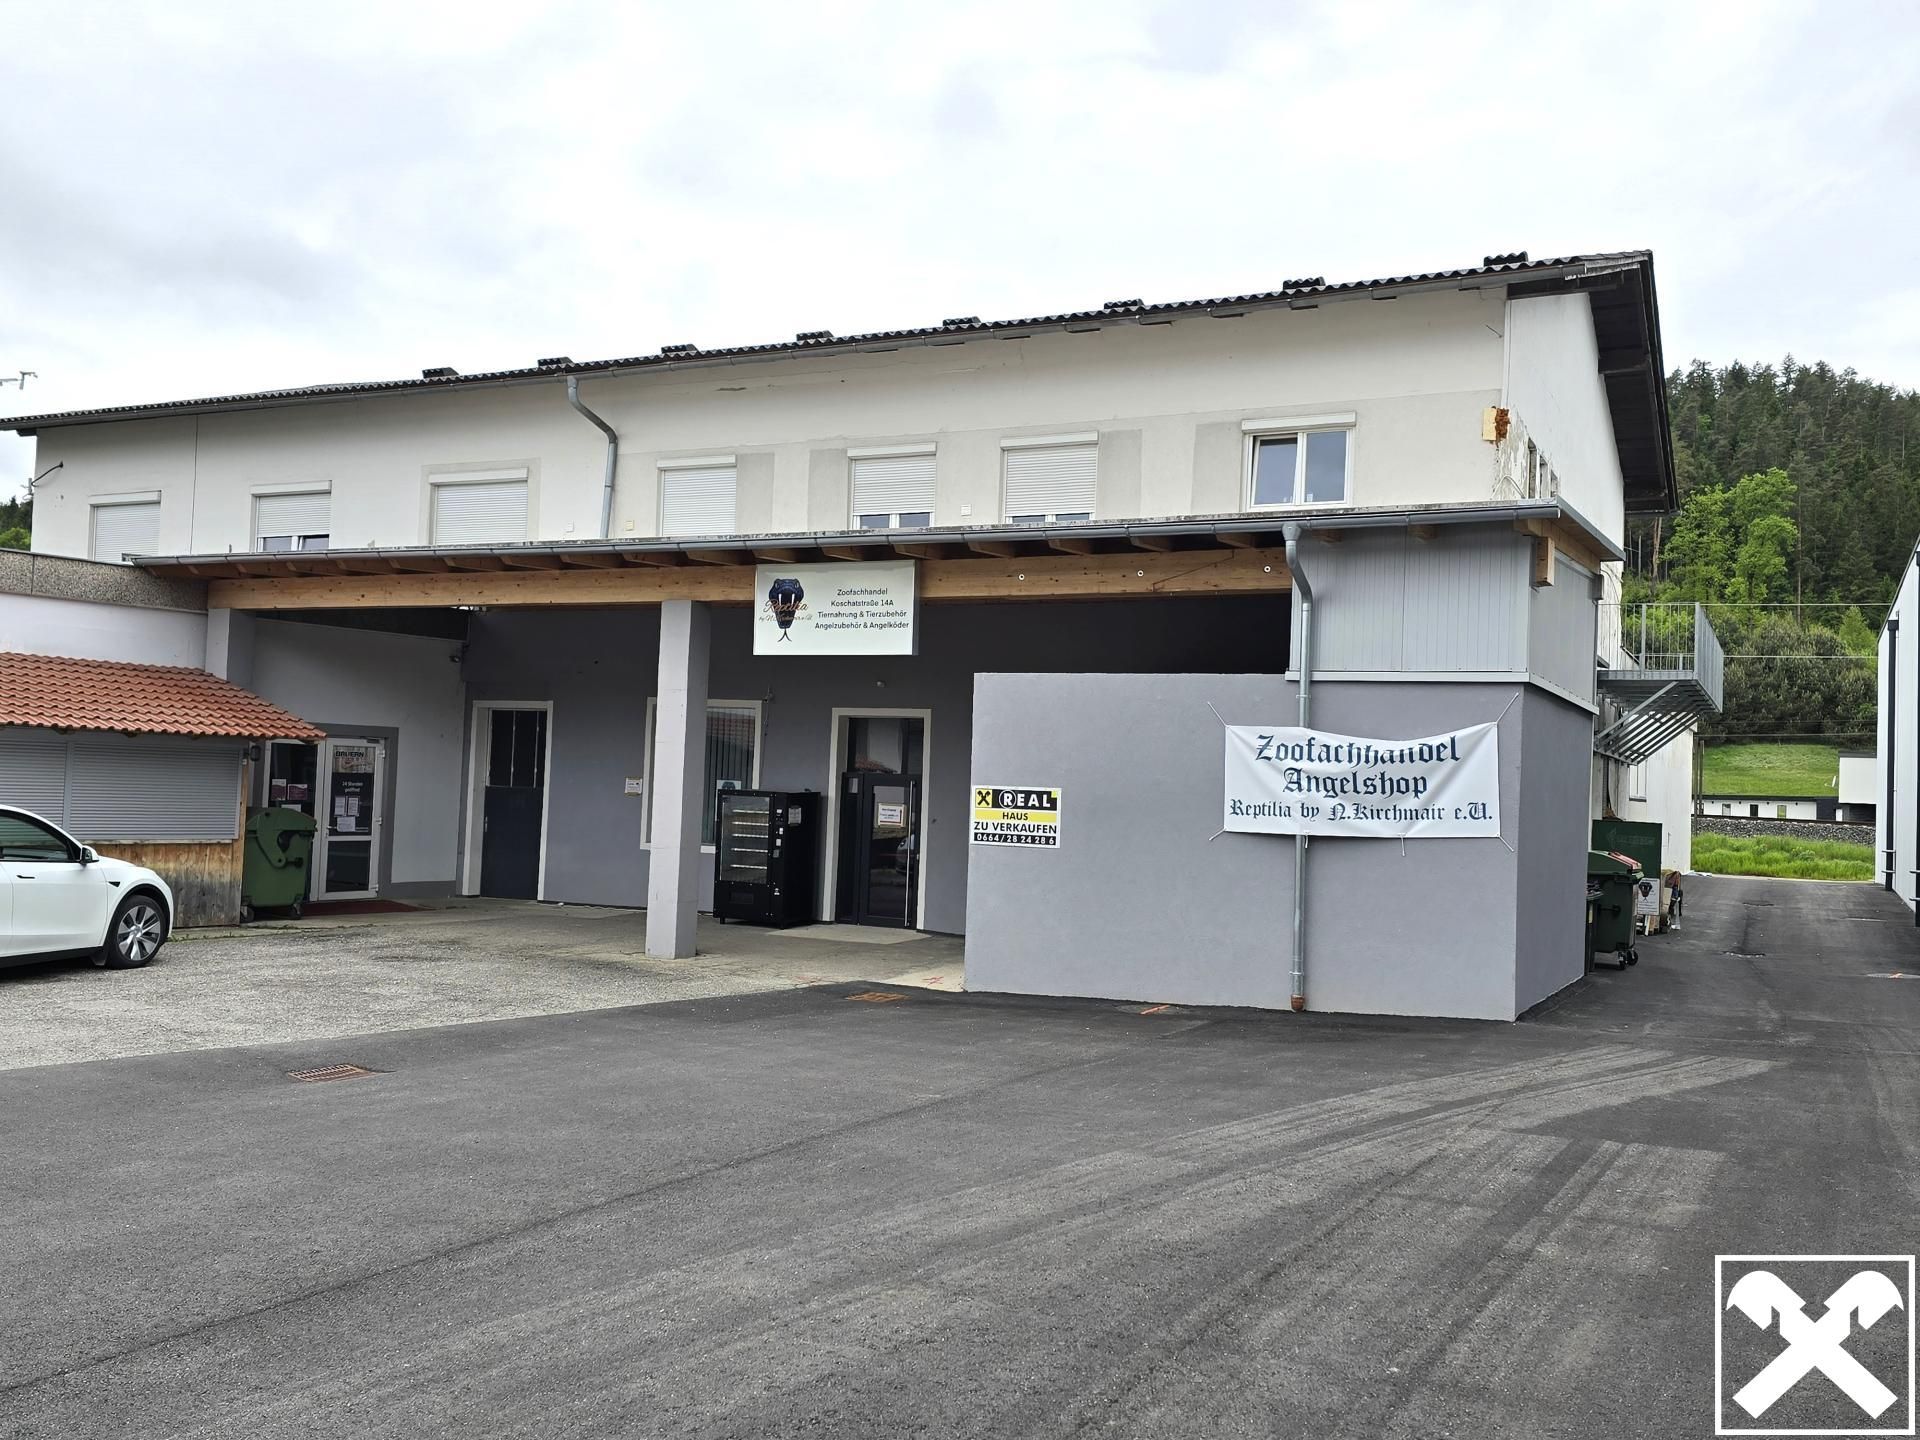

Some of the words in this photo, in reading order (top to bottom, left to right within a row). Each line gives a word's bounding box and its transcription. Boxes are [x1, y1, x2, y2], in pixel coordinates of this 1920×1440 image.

[837, 587, 888, 596] Zoofachhandel
[831, 599, 879, 607] Koschatstraße
[818, 611, 858, 619] Tiernahrung
[866, 610, 907, 618] Tierzubehör
[815, 622, 862, 631] Angelzubehör
[869, 621, 909, 630] Angelköder
[1255, 734, 1461, 768] Zoofachhandel
[1282, 767, 1428, 800] Angelshop
[1000, 790, 1051, 808] REAL
[1230, 799, 1292, 819] Reptilia
[1300, 802, 1320, 822] by
[1002, 812, 1029, 821] HAUS
[974, 821, 989, 831] ZU
[992, 822, 1057, 834] VERKAUFEN
